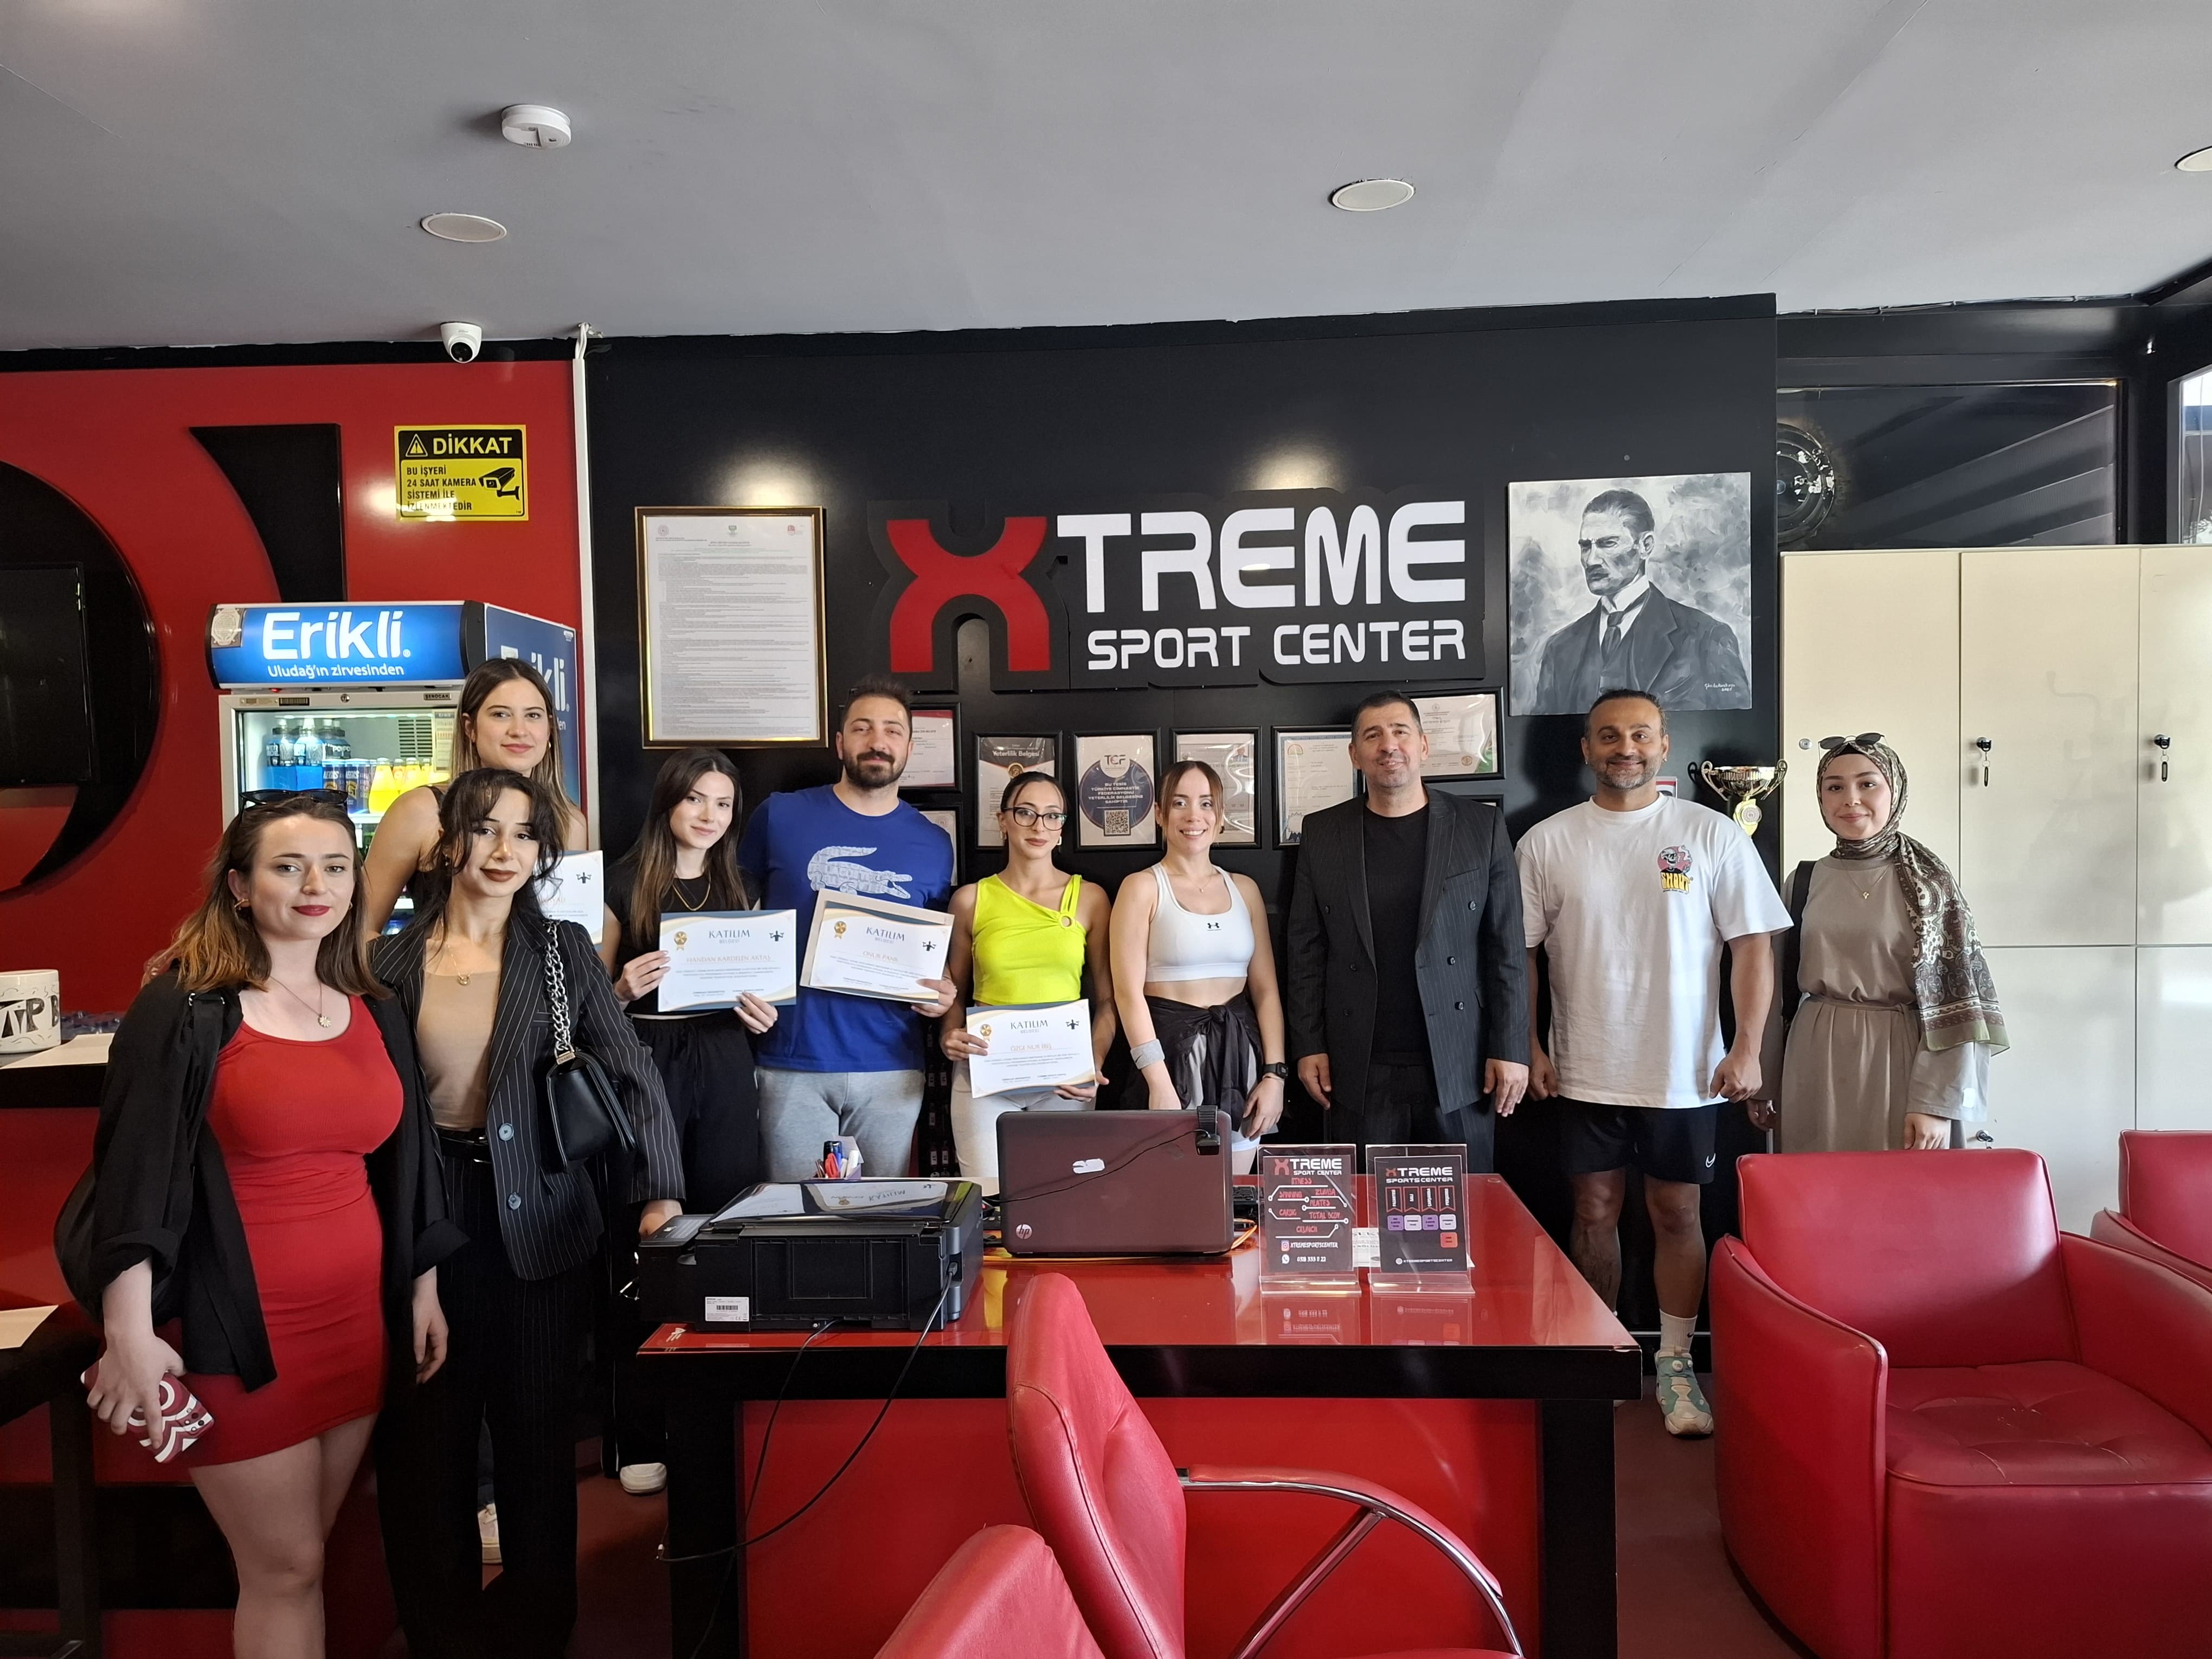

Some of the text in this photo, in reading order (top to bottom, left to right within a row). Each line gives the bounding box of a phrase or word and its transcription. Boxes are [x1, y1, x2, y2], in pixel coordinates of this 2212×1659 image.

[433, 433, 512, 455] DİKKAT
[407, 465, 446, 478] BU İŞYERİ
[420, 479, 439, 487] SAAT
[442, 478, 477, 486] KAMERA
[408, 491, 440, 499] SİSTEMİ
[262, 610, 403, 660] Erikli
[1088, 619, 1466, 670] SPORT CENTER
[267, 664, 404, 679] Uludağ'ın zirvesinden
[709, 929, 750, 938] KATILIM
[866, 927, 905, 941] KATILIM
[1010, 1019, 1049, 1030] KATILIM
[1274, 1158, 1342, 1175] XTREME
[1385, 1167, 1453, 1177] XTREME
